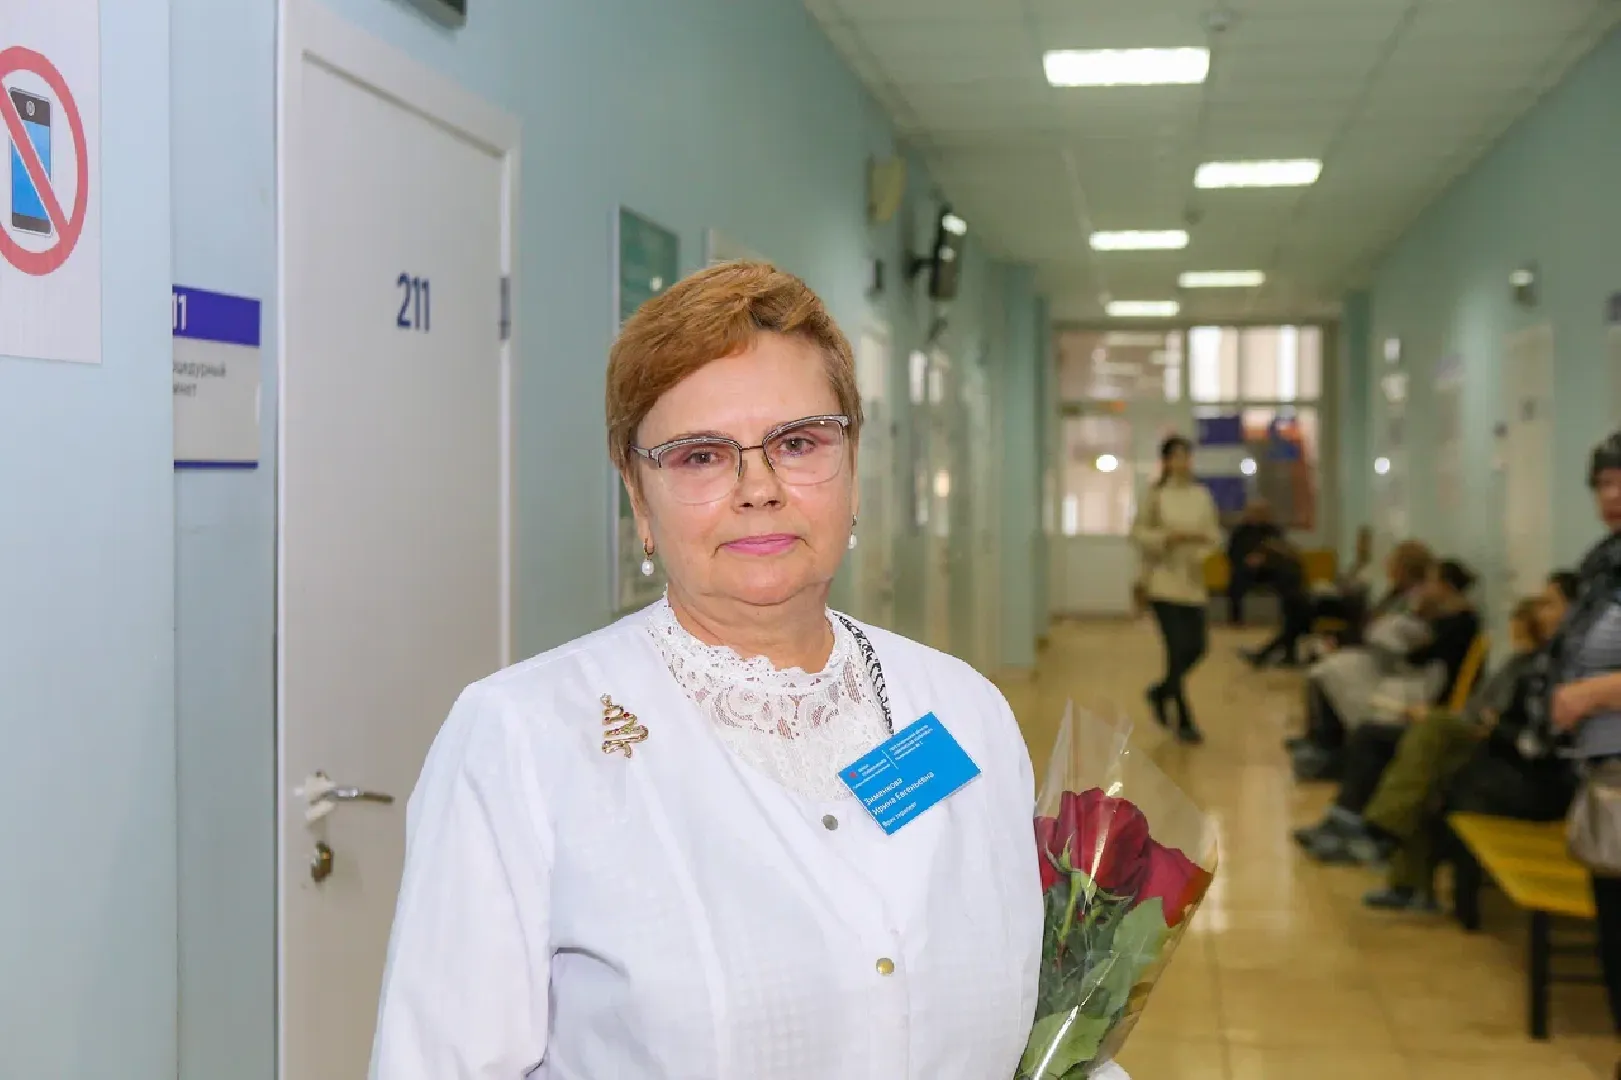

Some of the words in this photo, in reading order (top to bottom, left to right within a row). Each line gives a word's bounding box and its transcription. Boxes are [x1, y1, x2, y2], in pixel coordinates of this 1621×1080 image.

[397, 272, 430, 332] 211
[871, 796, 897, 816] Ирина
[895, 771, 935, 800] Евгеньевна
